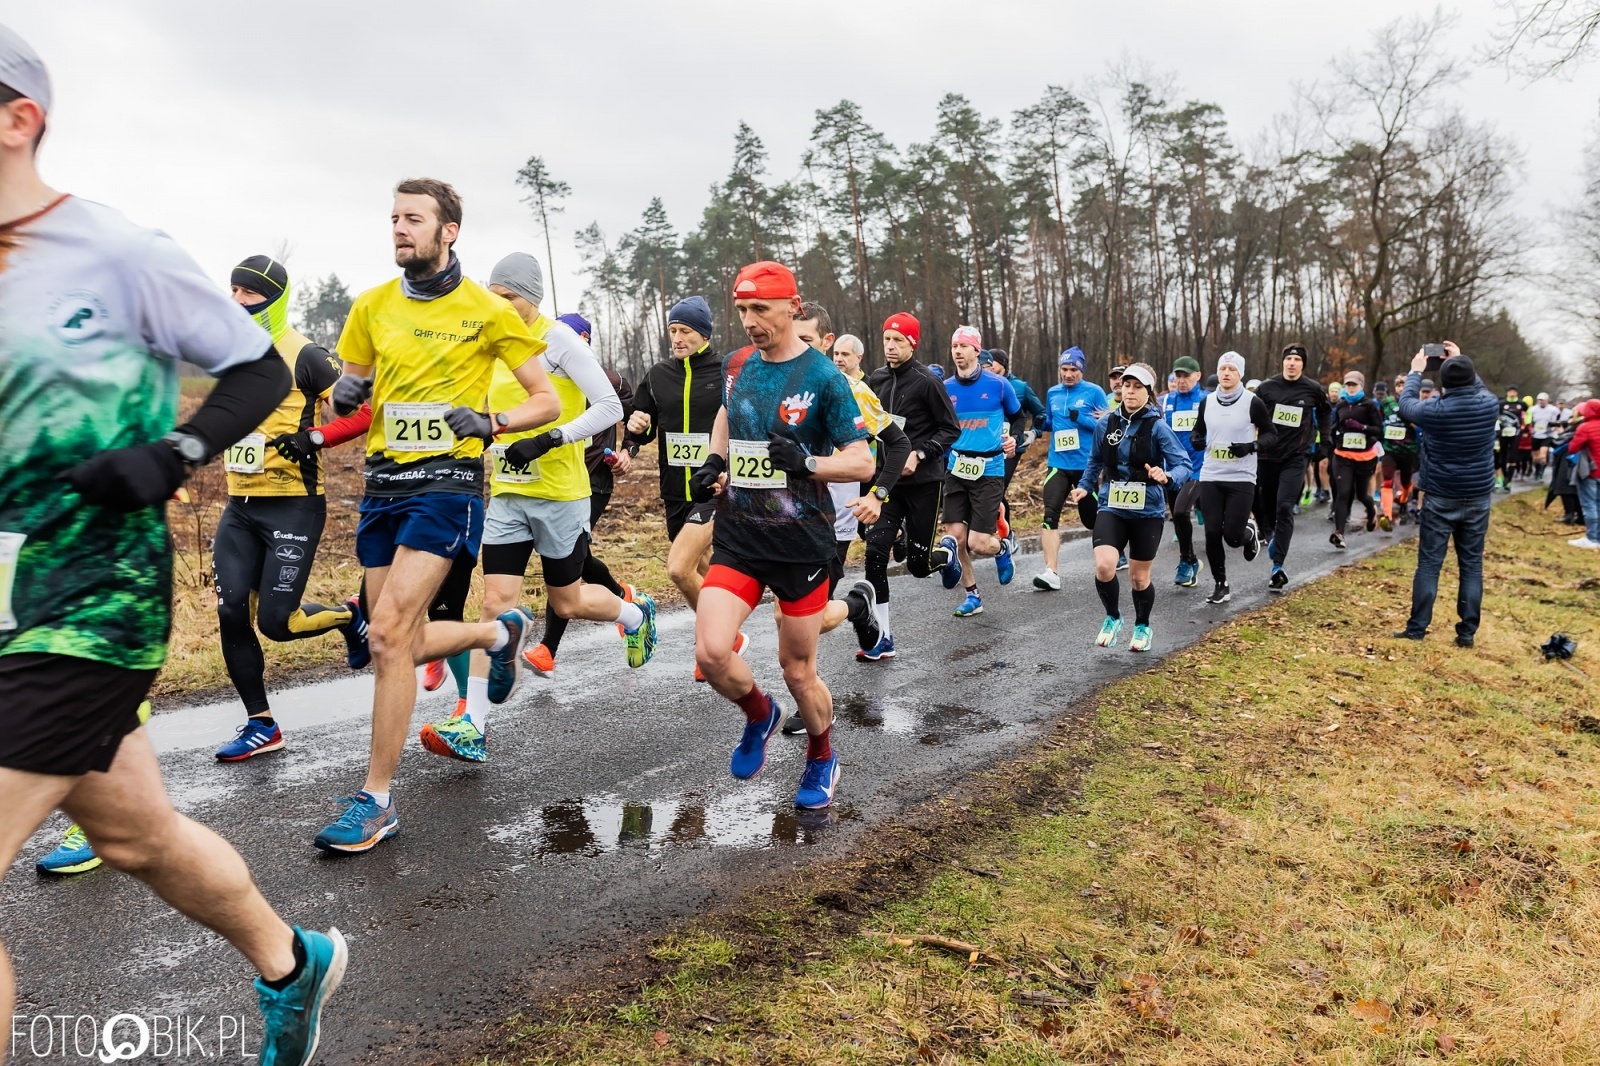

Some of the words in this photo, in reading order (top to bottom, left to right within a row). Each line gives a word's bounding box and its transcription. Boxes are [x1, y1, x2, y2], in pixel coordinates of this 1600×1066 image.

[461, 320, 484, 329] BIEG
[414, 328, 479, 343] CHRYSTUSEM
[1177, 418, 1197, 427] 217
[1278, 411, 1298, 423] 206
[395, 419, 442, 441] 215
[1058, 436, 1075, 447] 158
[227, 445, 255, 464] 176
[673, 444, 702, 460] 237
[736, 456, 775, 478] 229
[958, 462, 979, 475] 260
[1114, 490, 1139, 504] 173
